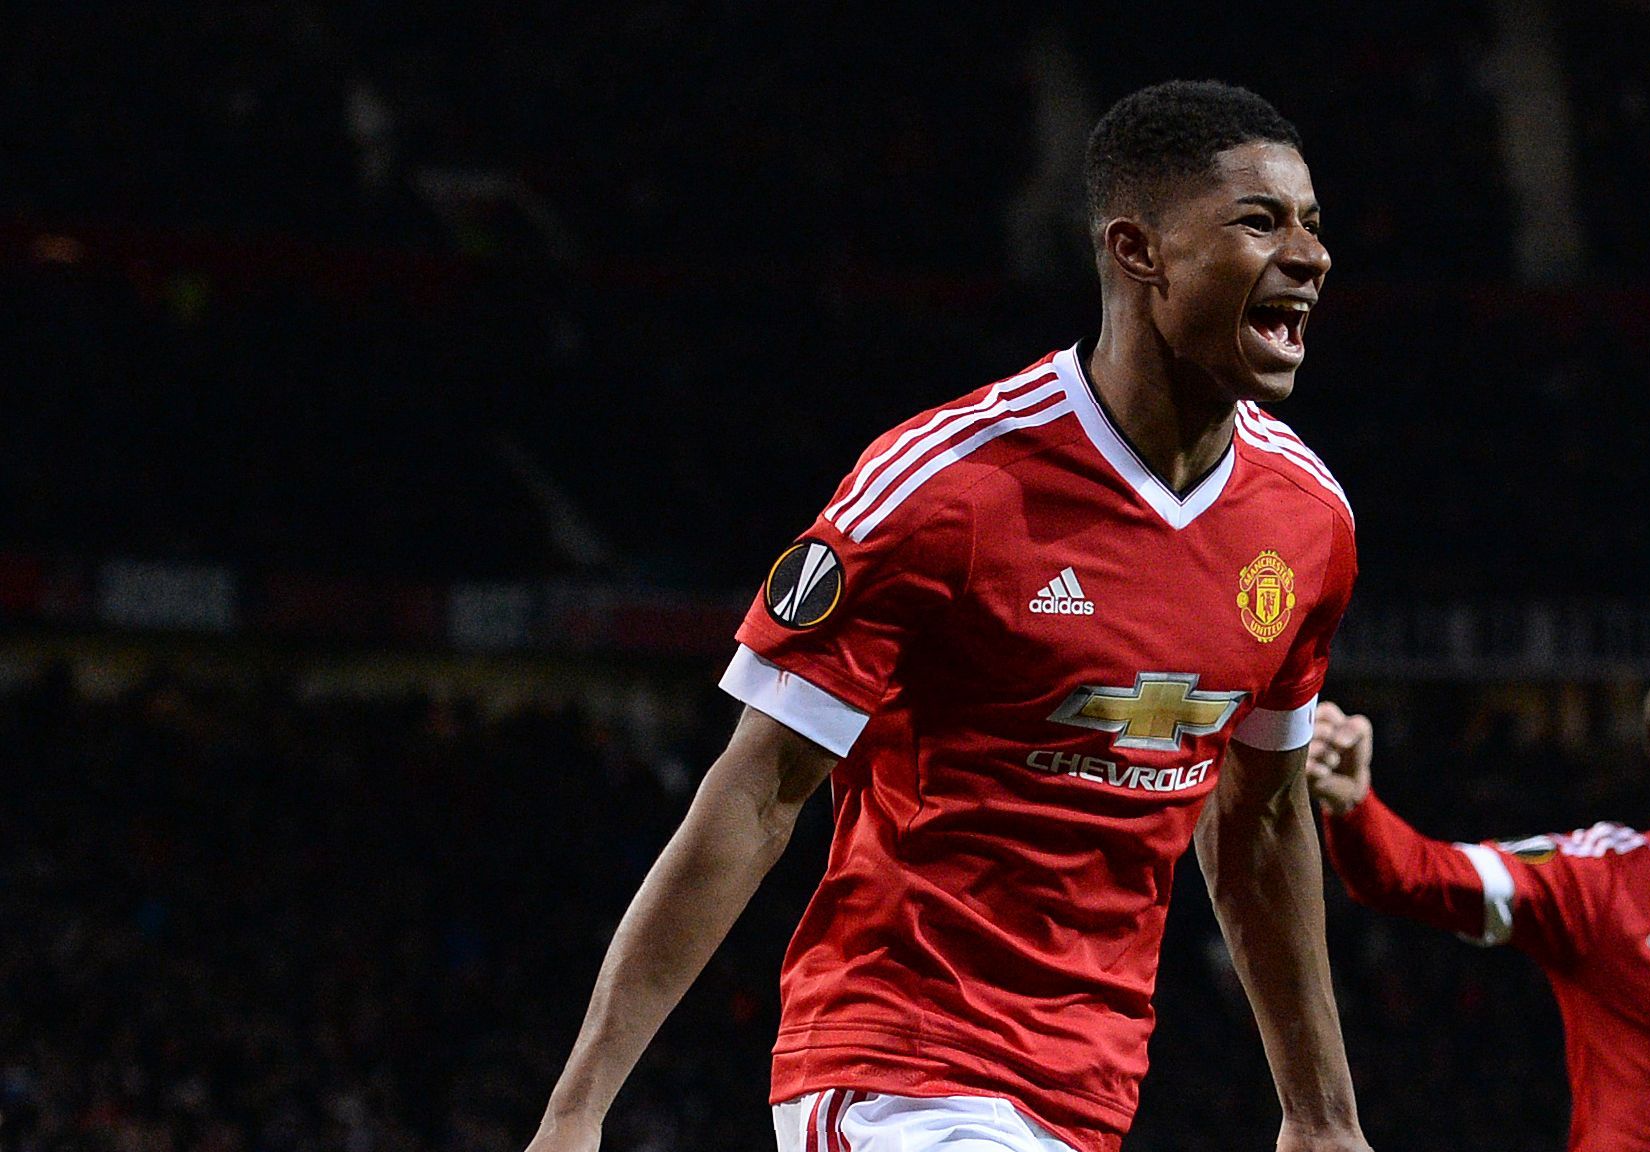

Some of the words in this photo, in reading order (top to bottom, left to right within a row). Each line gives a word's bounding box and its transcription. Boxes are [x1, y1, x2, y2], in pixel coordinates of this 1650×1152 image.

[1029, 596, 1095, 615] adidas
[1250, 620, 1283, 636] UNITED
[1026, 750, 1214, 792] CHEVROLET
